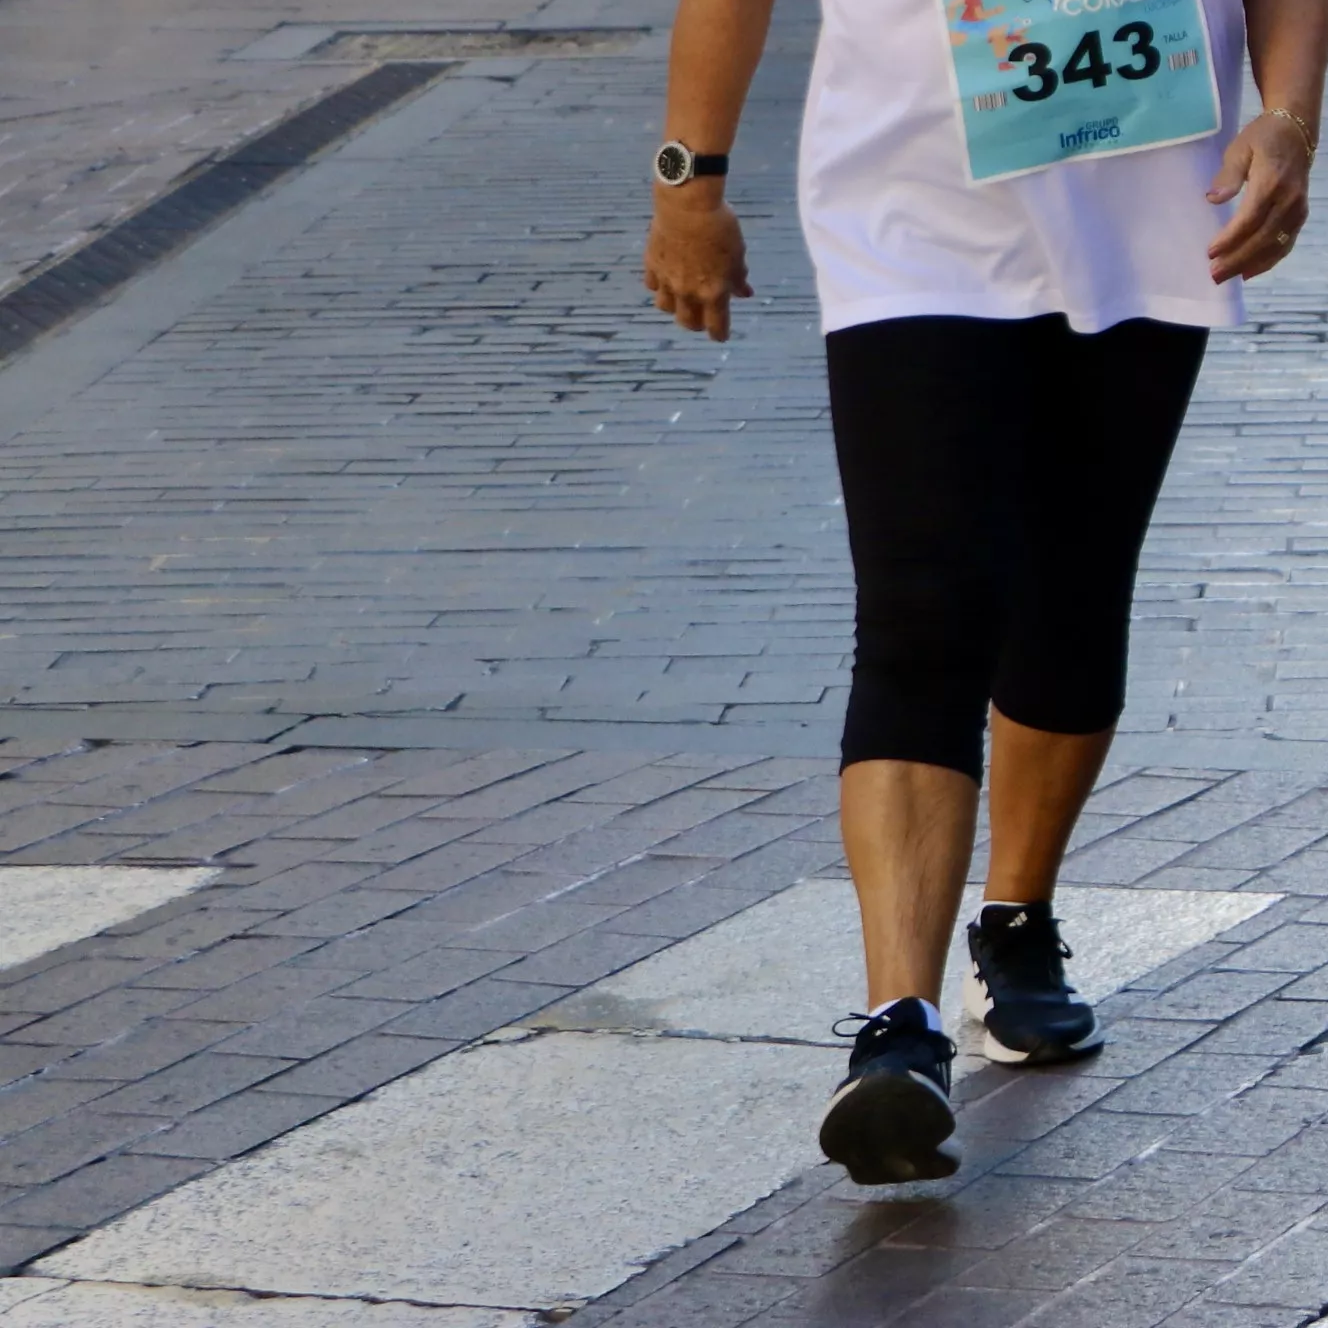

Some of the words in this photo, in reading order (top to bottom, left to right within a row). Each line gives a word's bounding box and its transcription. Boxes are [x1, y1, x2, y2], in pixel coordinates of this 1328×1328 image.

[1163, 30, 1189, 44] TALLA
[1008, 21, 1161, 102] 343
[1060, 126, 1121, 148] Infrico
